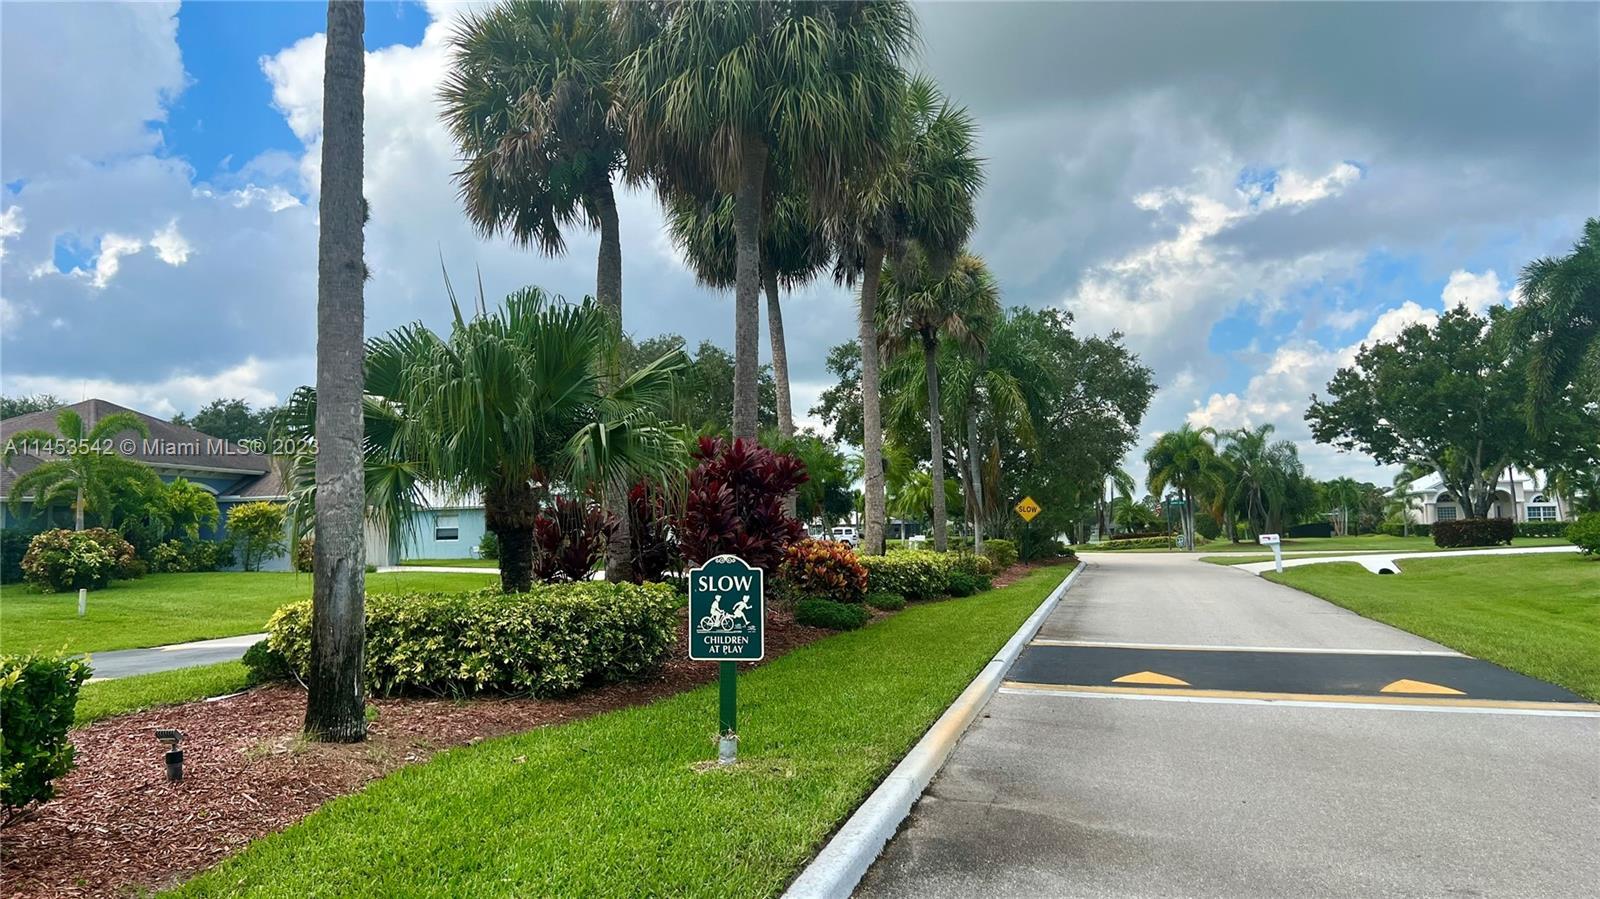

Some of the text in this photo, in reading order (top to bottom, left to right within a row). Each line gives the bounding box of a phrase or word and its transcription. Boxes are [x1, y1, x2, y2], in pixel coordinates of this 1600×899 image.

[698, 575, 753, 592] SLOW
[703, 636, 749, 645] CHILDREN
[709, 645, 744, 654] AT PLAY
